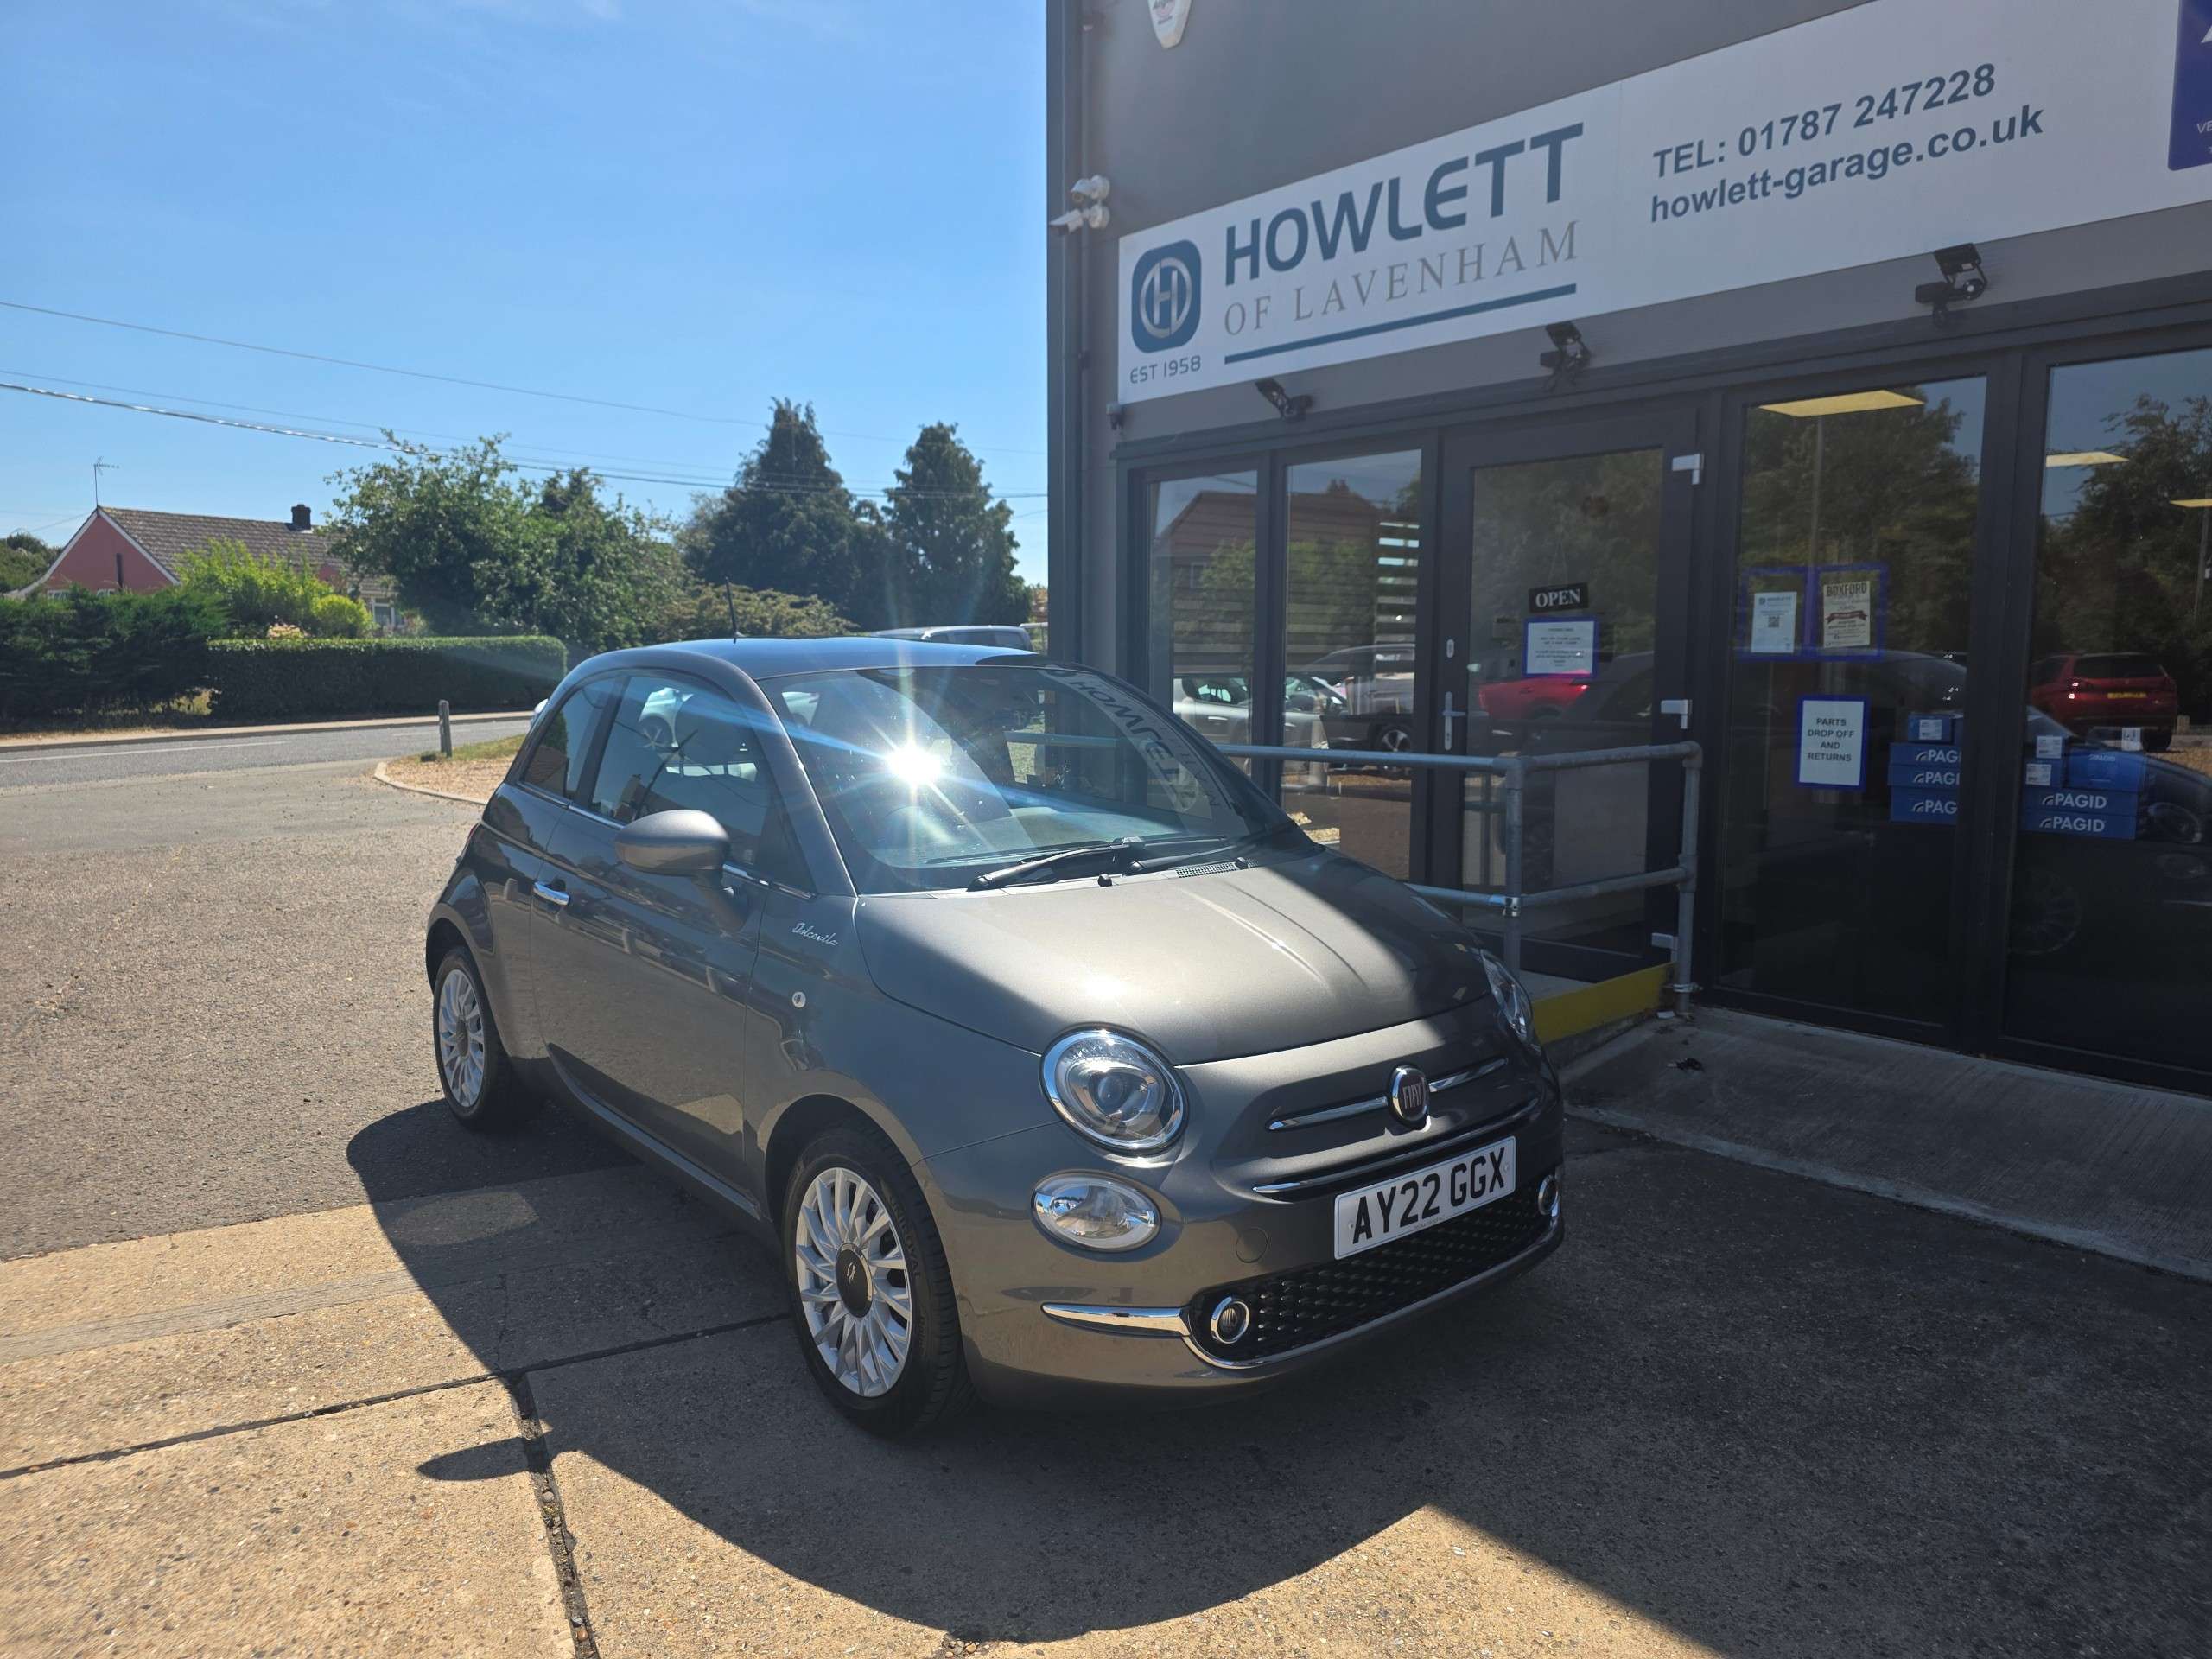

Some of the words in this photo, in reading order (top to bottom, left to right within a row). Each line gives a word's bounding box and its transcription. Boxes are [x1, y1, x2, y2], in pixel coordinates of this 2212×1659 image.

[1652, 138, 1726, 179] TEL:
[1738, 105, 1842, 157] 01787
[1853, 63, 1996, 129] 247228
[1650, 103, 2044, 223] howlett-garage.co.uk
[1224, 122, 1584, 287] HOWLETT
[1224, 295, 1272, 336] OF
[1294, 219, 1580, 322] LAVENHAM
[1130, 363, 1159, 384] EST
[1163, 354, 1201, 378] 1958
[1535, 588, 1580, 607] OPEN
[1816, 718, 1847, 727] PARTS
[1808, 729, 1834, 738] DROP
[1808, 753, 1852, 761] RETURNS
[1928, 749, 1961, 763] PAG
[1925, 772, 1960, 785] PAGI
[1924, 800, 1957, 814] PAG
[2055, 793, 2107, 810] PAGID
[2052, 817, 2106, 832] PAGID
[1402, 1083, 1424, 1109] FIAT
[1352, 1173, 1440, 1244] AY22
[1450, 1147, 1505, 1207] GGX
